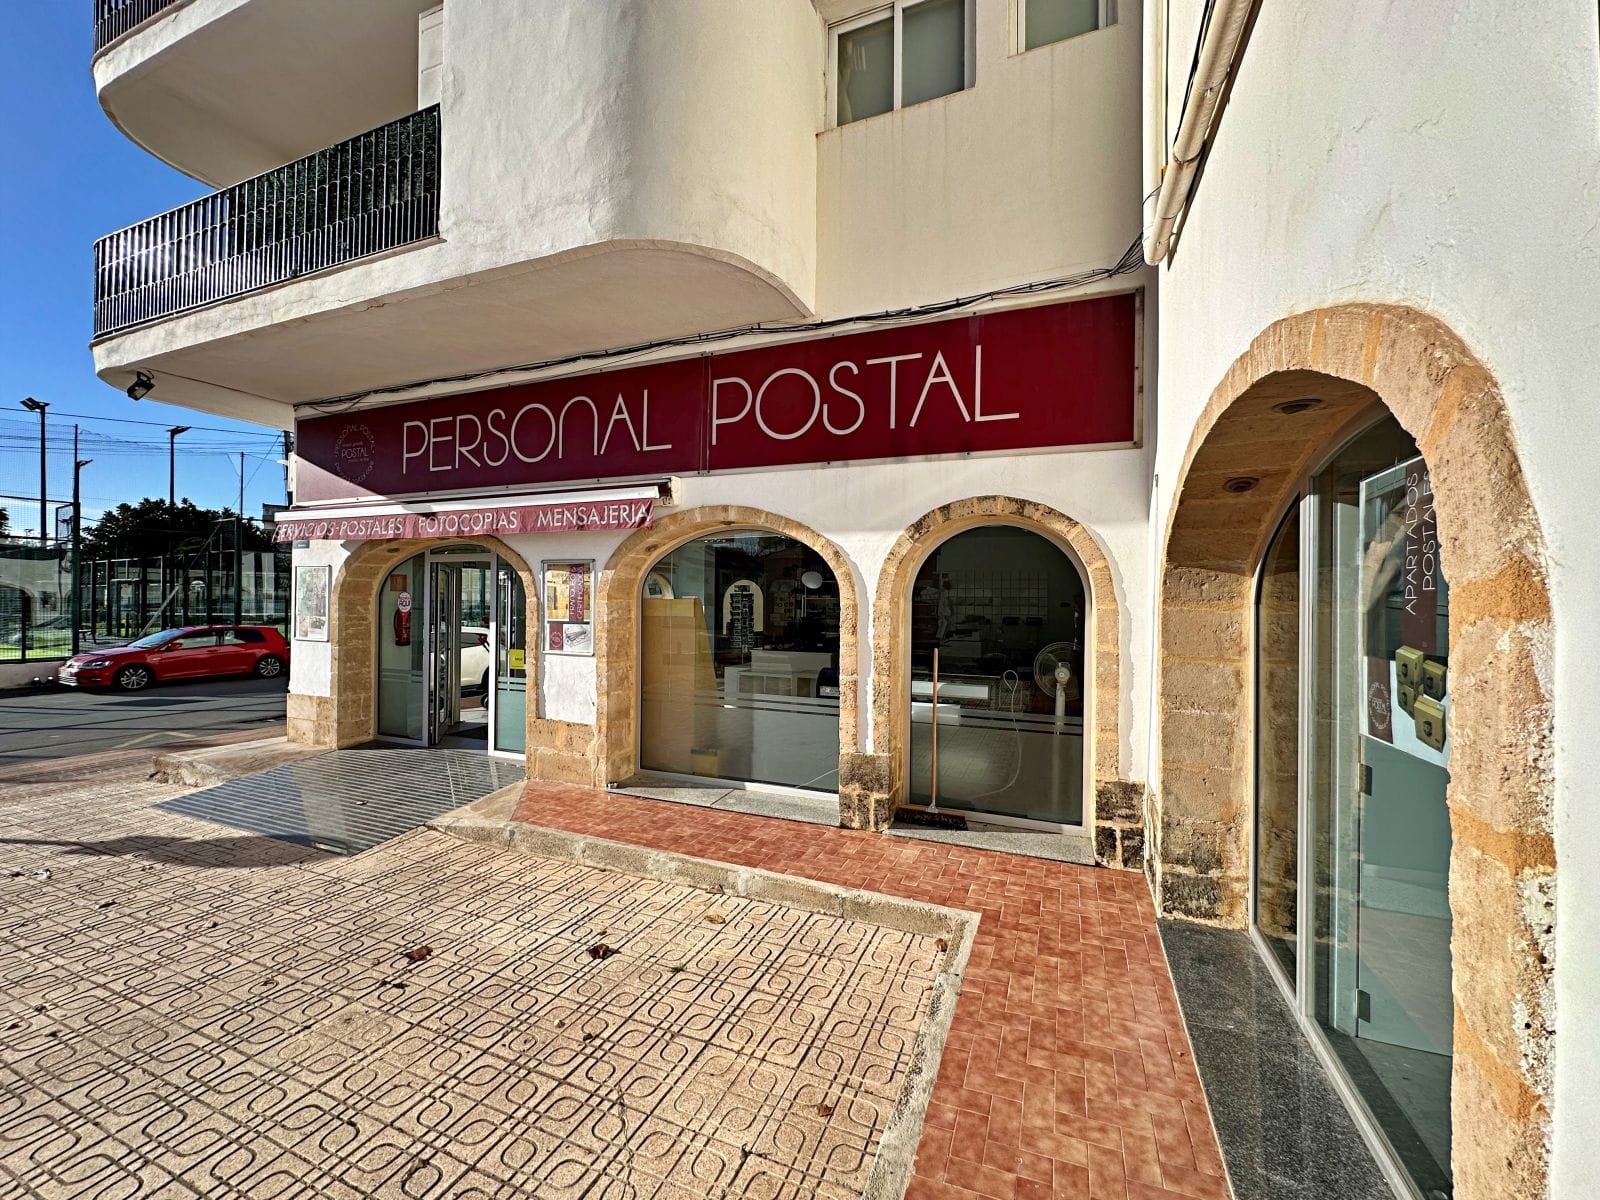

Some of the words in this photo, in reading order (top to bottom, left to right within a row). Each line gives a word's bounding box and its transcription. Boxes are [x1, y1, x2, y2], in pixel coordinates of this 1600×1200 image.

[402, 389, 673, 475] PERSONAL
[711, 344, 1020, 446] POSTAL
[342, 448, 369, 459] POSTAL
[418, 510, 518, 533] FOTOCOPIAS
[536, 502, 651, 528] MENSAJERIA
[1404, 472, 1419, 616] APARTADOS
